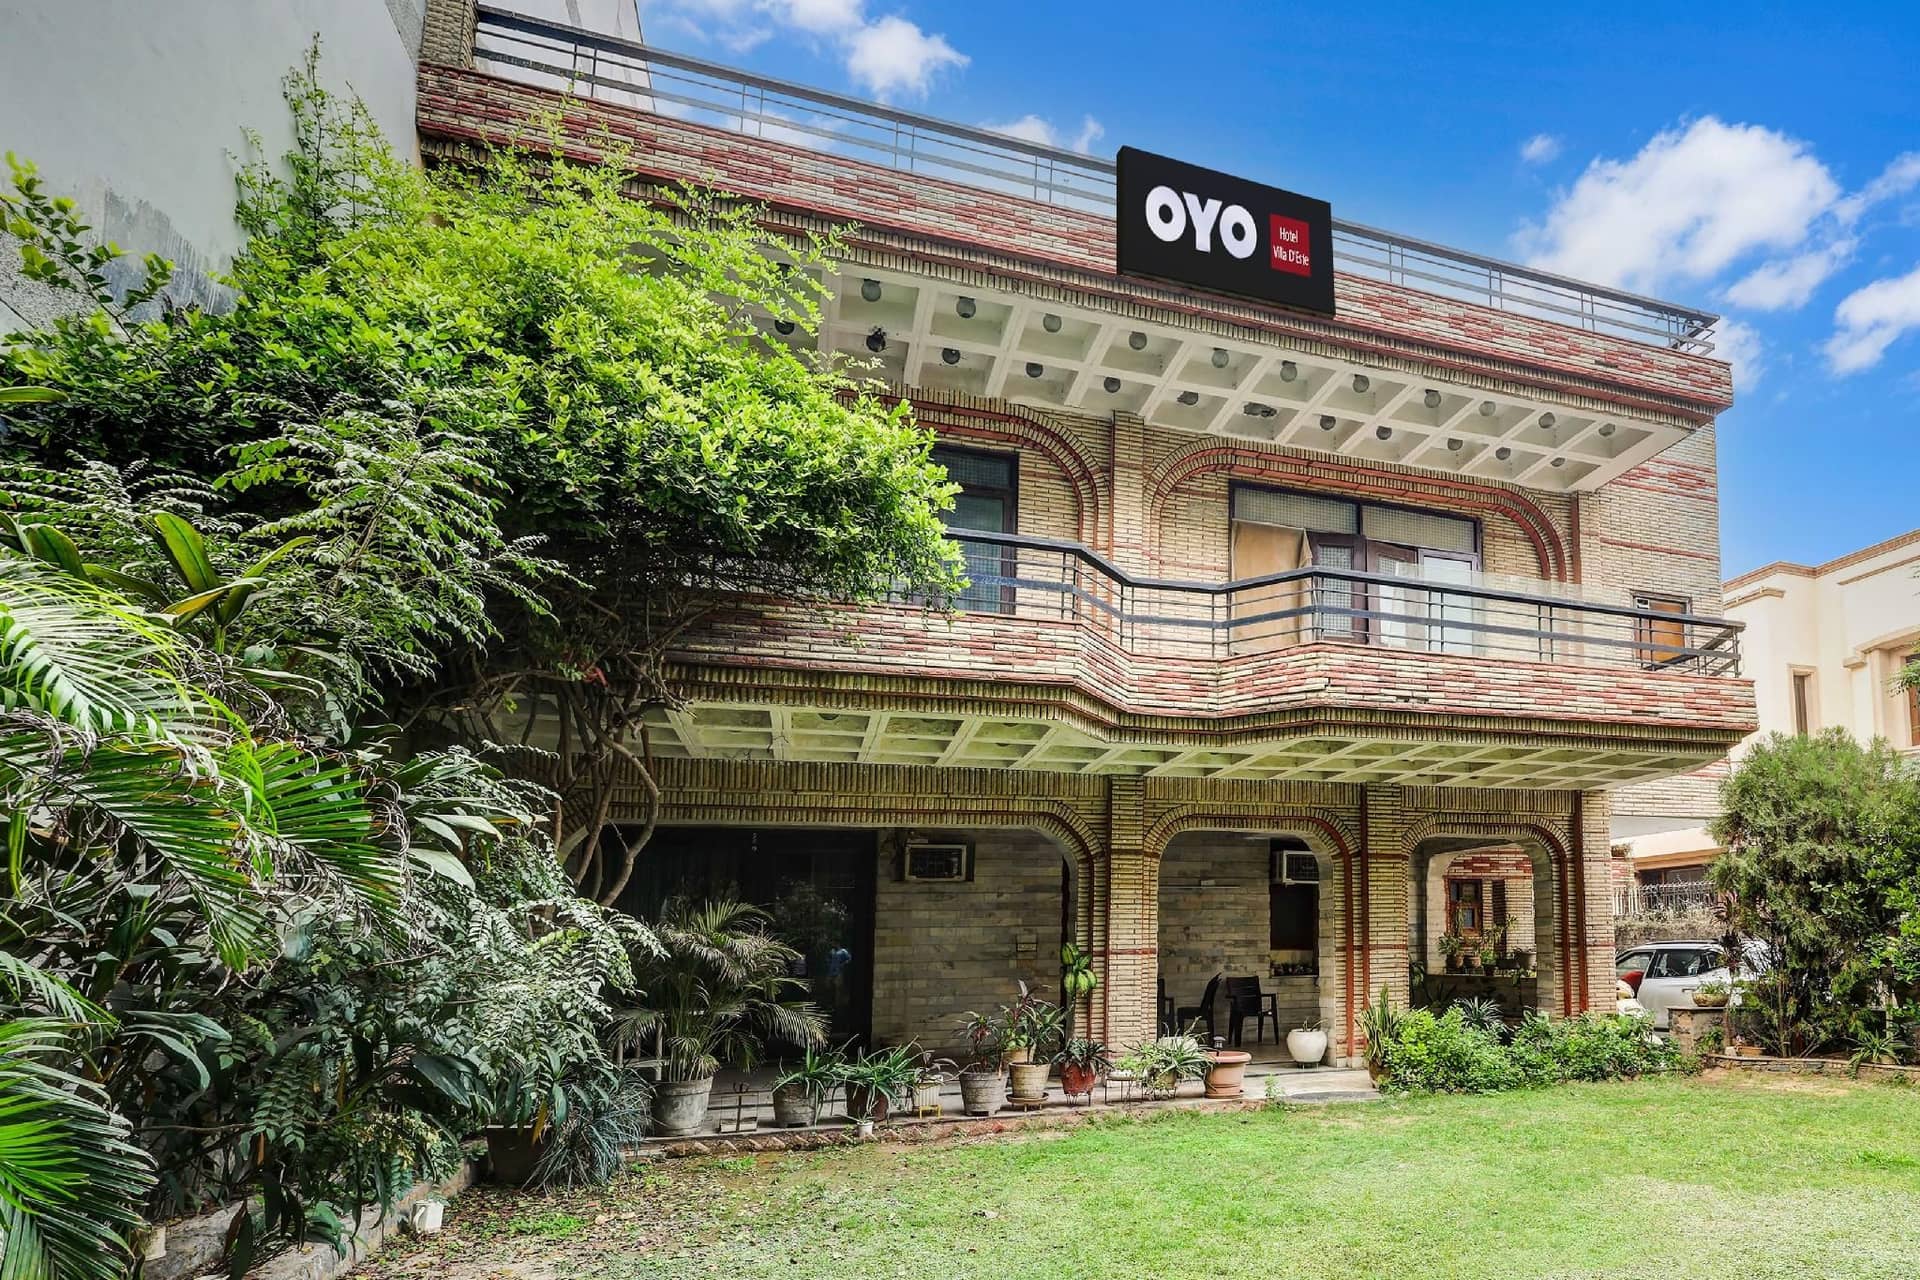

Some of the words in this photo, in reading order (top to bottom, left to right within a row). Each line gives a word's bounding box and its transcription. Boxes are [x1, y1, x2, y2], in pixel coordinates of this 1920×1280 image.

[1145, 185, 1257, 259] OYO
[1279, 226, 1298, 243] Hotel
[1273, 245, 1287, 261] Villa
